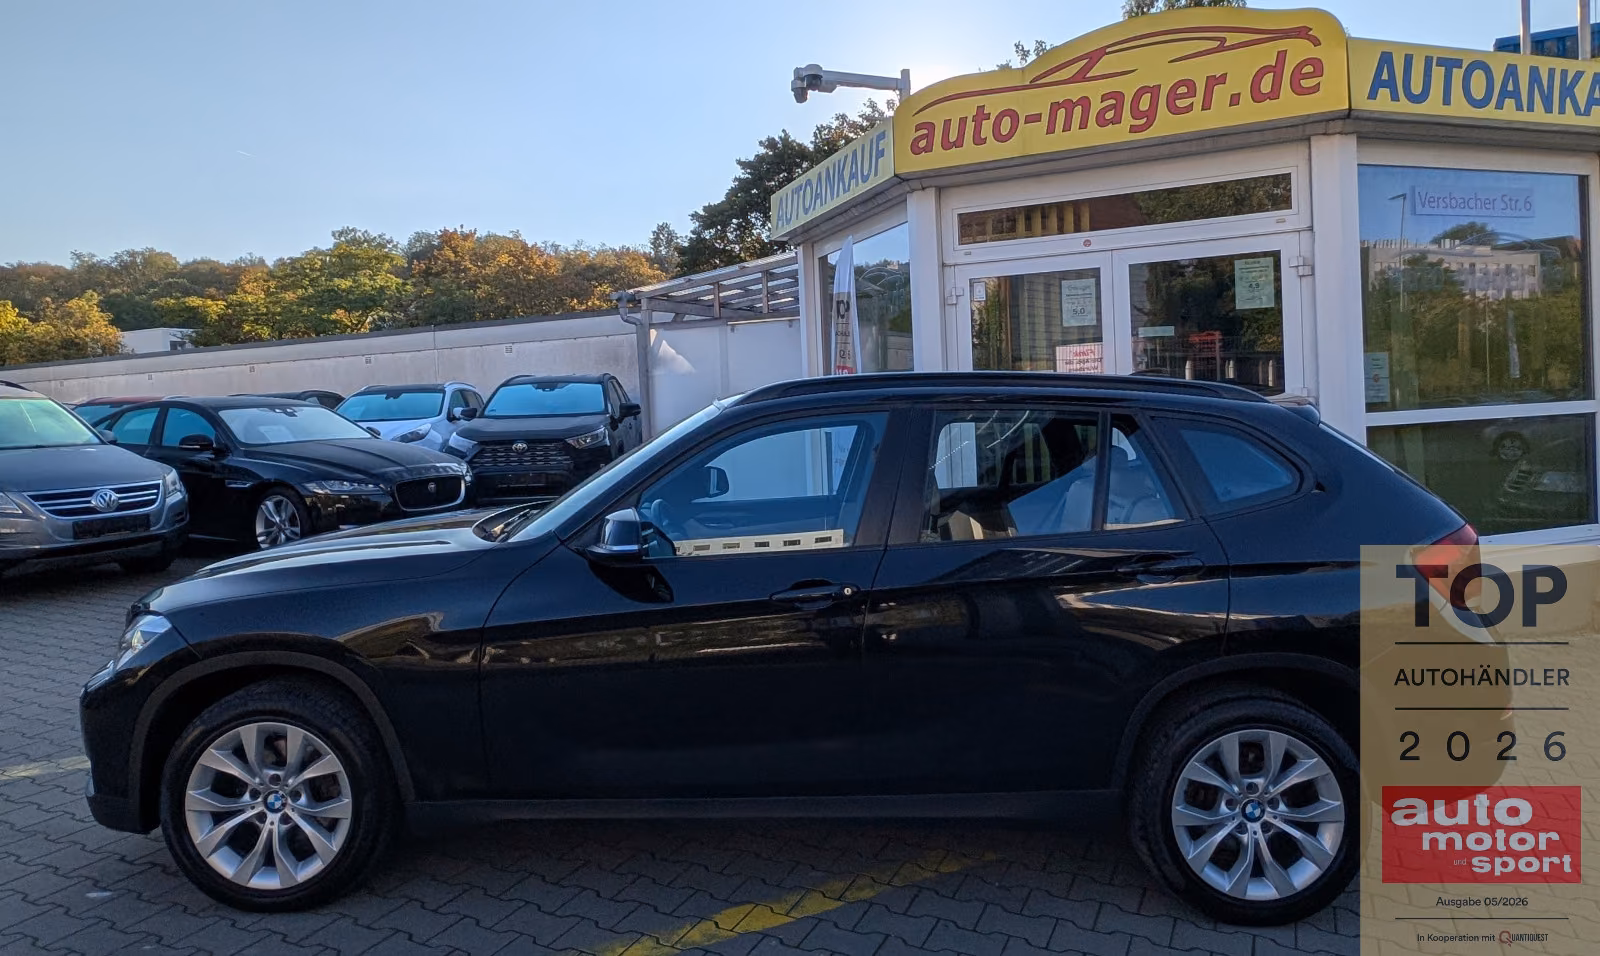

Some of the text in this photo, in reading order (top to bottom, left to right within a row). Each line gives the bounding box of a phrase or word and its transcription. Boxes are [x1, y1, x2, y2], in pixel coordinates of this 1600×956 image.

[910, 50, 1324, 156] auto-mager.de
[776, 130, 886, 230] AUTOANKAUF
[1418, 191, 1497, 212] Versbacher
